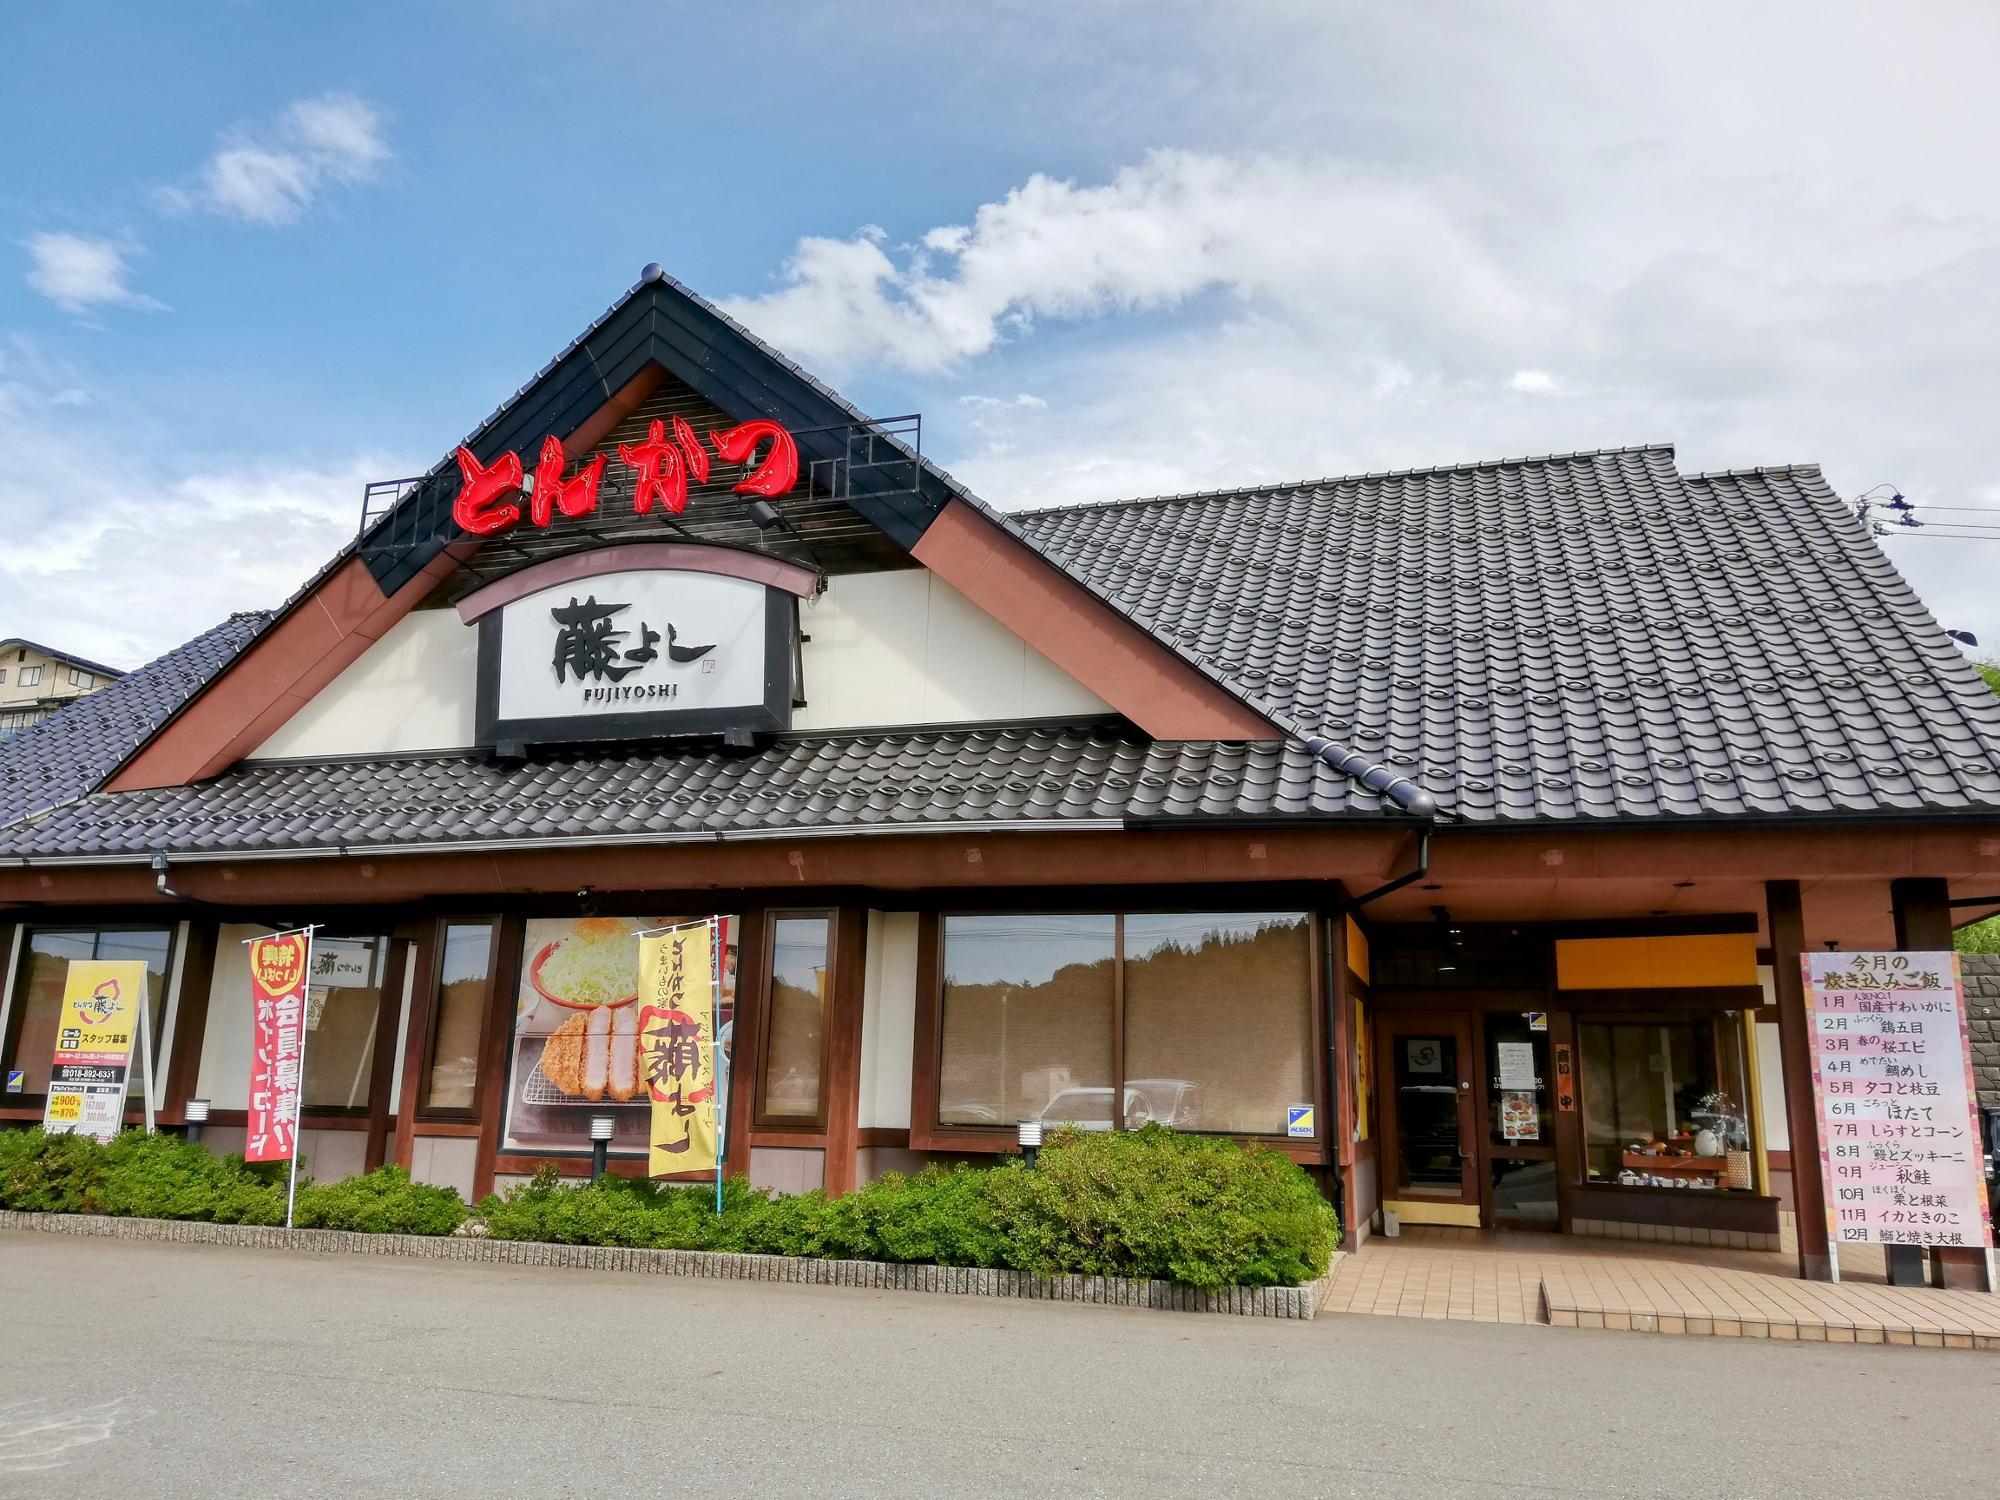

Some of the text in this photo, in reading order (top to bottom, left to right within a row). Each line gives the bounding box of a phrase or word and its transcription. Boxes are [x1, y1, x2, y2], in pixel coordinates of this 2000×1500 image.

[453, 415, 798, 535] とんかつ
[551, 595, 717, 683] 藤よし
[584, 684, 678, 702] FUJIYOSHI
[1851, 955, 1909, 971] 今月の
[1824, 971, 1942, 990] 炊き込みご飯
[1823, 992, 1951, 1013] 1月 人気NO.1 国産ずわいがに
[1824, 1014, 1923, 1034] 2月 ふっくら 鶏五目
[81, 1034, 128, 1044] スタッフ募集
[1825, 1035, 1926, 1053] 3月 春の 桜エビ
[1827, 1060, 1851, 1073] 4月
[1885, 1064, 1928, 1078] 鯛めし
[1830, 1081, 1940, 1096] 5月 タコと枝豆
[60, 1096, 76, 1106] 900
[60, 1109, 75, 1117] 870
[1832, 1102, 1855, 1115] 6月
[1887, 1106, 1934, 1121] ほたて
[1834, 1123, 1964, 1138] 7月 しらすとコーン
[1836, 1145, 1860, 1158] 8月
[1838, 1162, 1932, 1185] 9月 ジューシー 秋鮭
[1838, 1186, 1948, 1207] 10月 ほくほく 栗と根菜
[1840, 1208, 1960, 1225] 11月 イカときのこ
[1842, 1228, 1868, 1242] 12月
